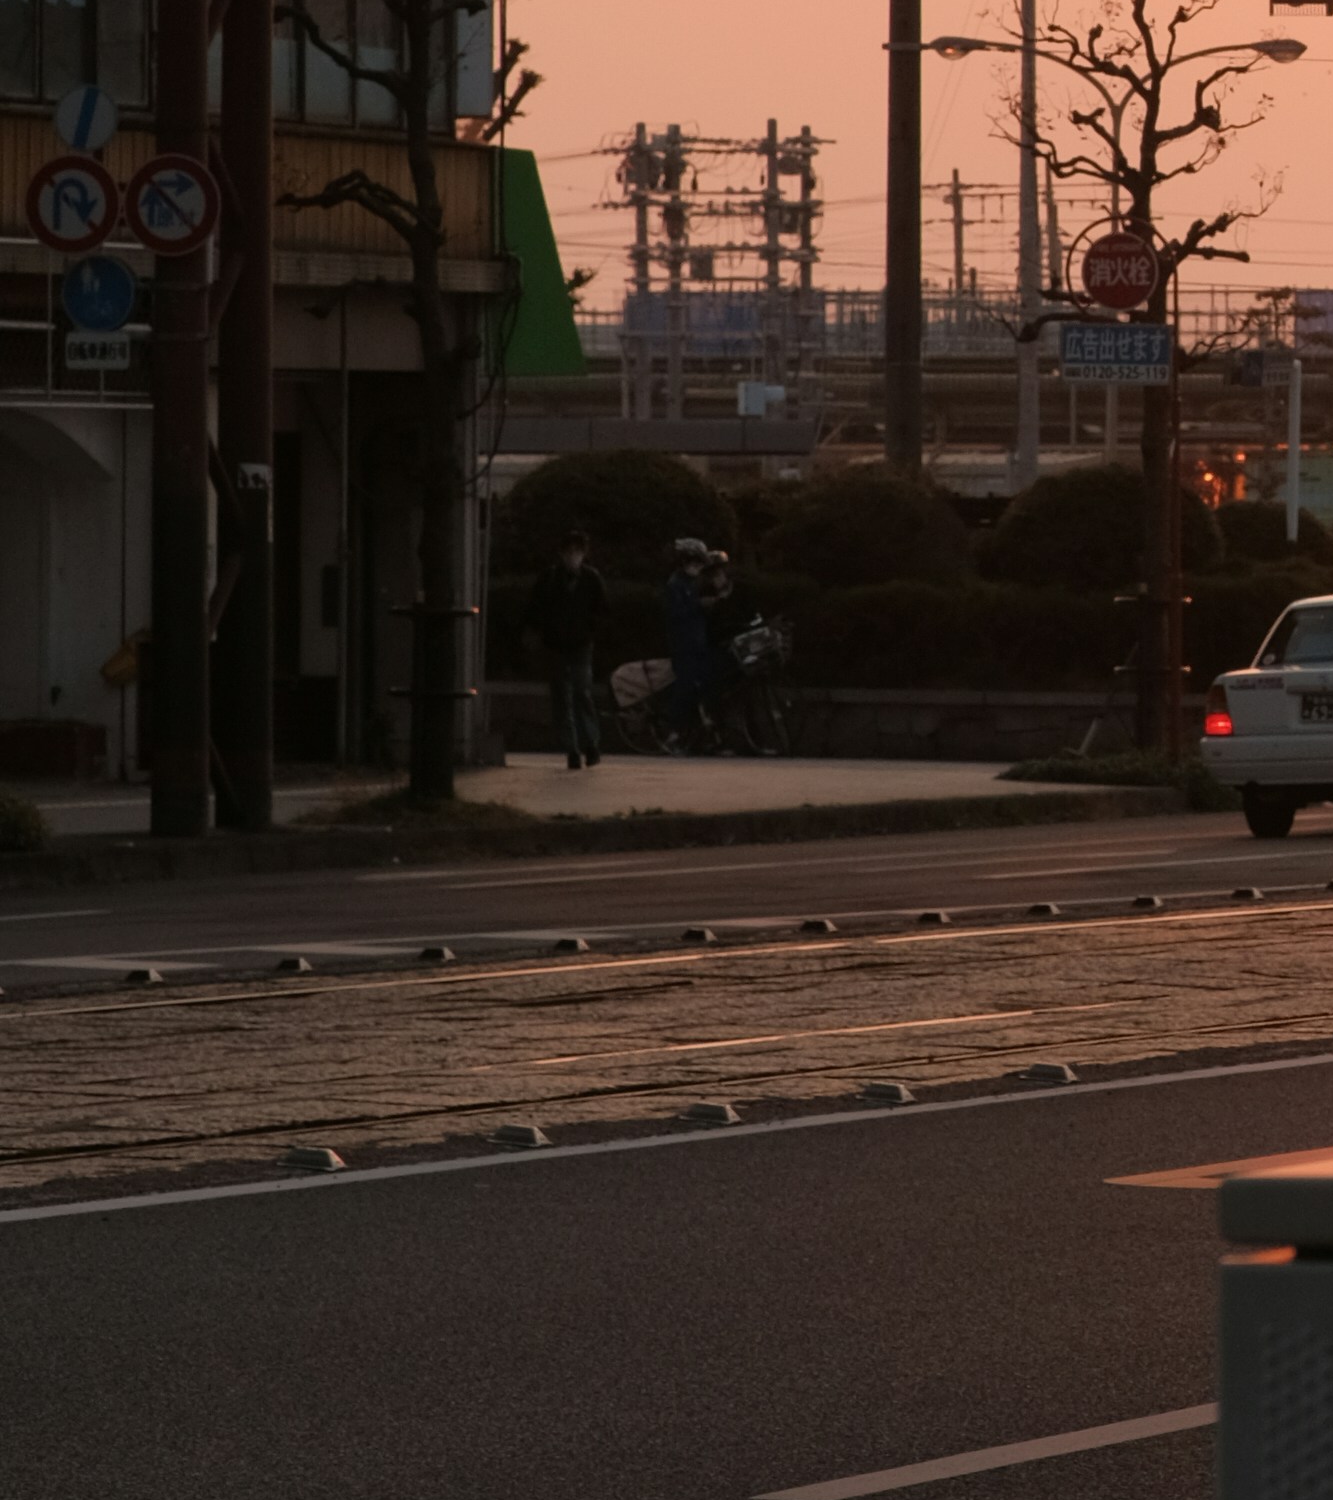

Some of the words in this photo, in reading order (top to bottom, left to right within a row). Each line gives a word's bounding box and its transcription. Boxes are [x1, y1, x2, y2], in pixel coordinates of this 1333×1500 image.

[1089, 255, 1152, 288] 消火栓
[1064, 327, 1166, 362] 広告出せます
[1082, 365, 1167, 380] 0120-525-119
